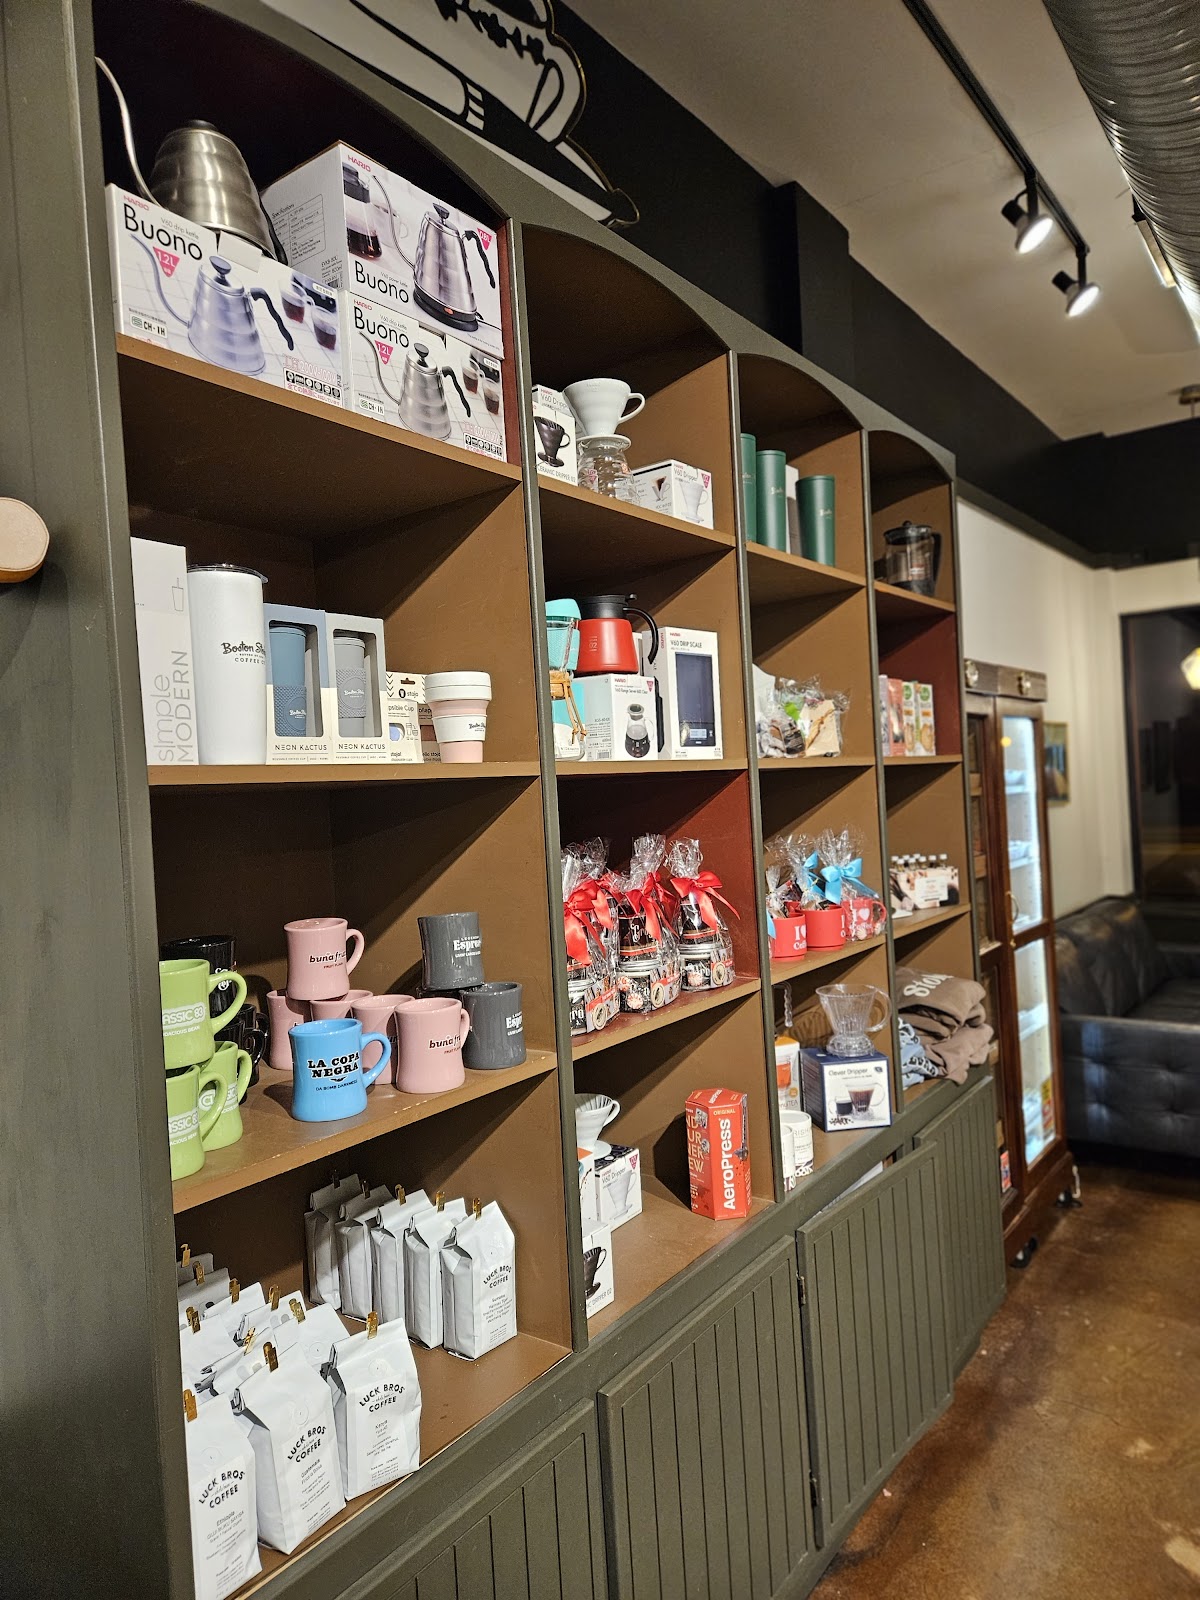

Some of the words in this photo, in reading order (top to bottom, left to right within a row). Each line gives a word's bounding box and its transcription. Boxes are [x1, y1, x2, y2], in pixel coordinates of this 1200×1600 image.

[347, 154, 371, 173] HARIO
[123, 195, 150, 211] HARIO
[123, 203, 203, 261] Buono
[354, 260, 409, 303] Buono
[353, 299, 373, 311] HARIO
[353, 305, 410, 348] Buono
[220, 640, 255, 655] Boston
[689, 640, 703, 648] SCALE
[171, 650, 194, 763] MODERN
[403, 704, 415, 712] Cup
[150, 674, 174, 763] simple
[193, 1005, 204, 1020] 83
[307, 1059, 327, 1069] LA
[331, 1051, 360, 1066] COPA
[311, 1061, 359, 1078] NEGRA
[713, 1108, 736, 1116] ORIGINAL
[719, 1117, 736, 1210] AeroPress
[482, 1268, 498, 1285] LUCK
[488, 1275, 509, 1289] COFFEE
[358, 1386, 381, 1407] LUCK
[383, 1383, 406, 1394] BROS
[368, 1395, 397, 1413] COFFEE
[287, 1434, 306, 1460] LUCK
[307, 1425, 327, 1438] BROS
[295, 1438, 321, 1463] COFFEE
[198, 1477, 219, 1504] LUCK
[220, 1469, 245, 1481] BROS
[208, 1483, 239, 1509] COFFEE
